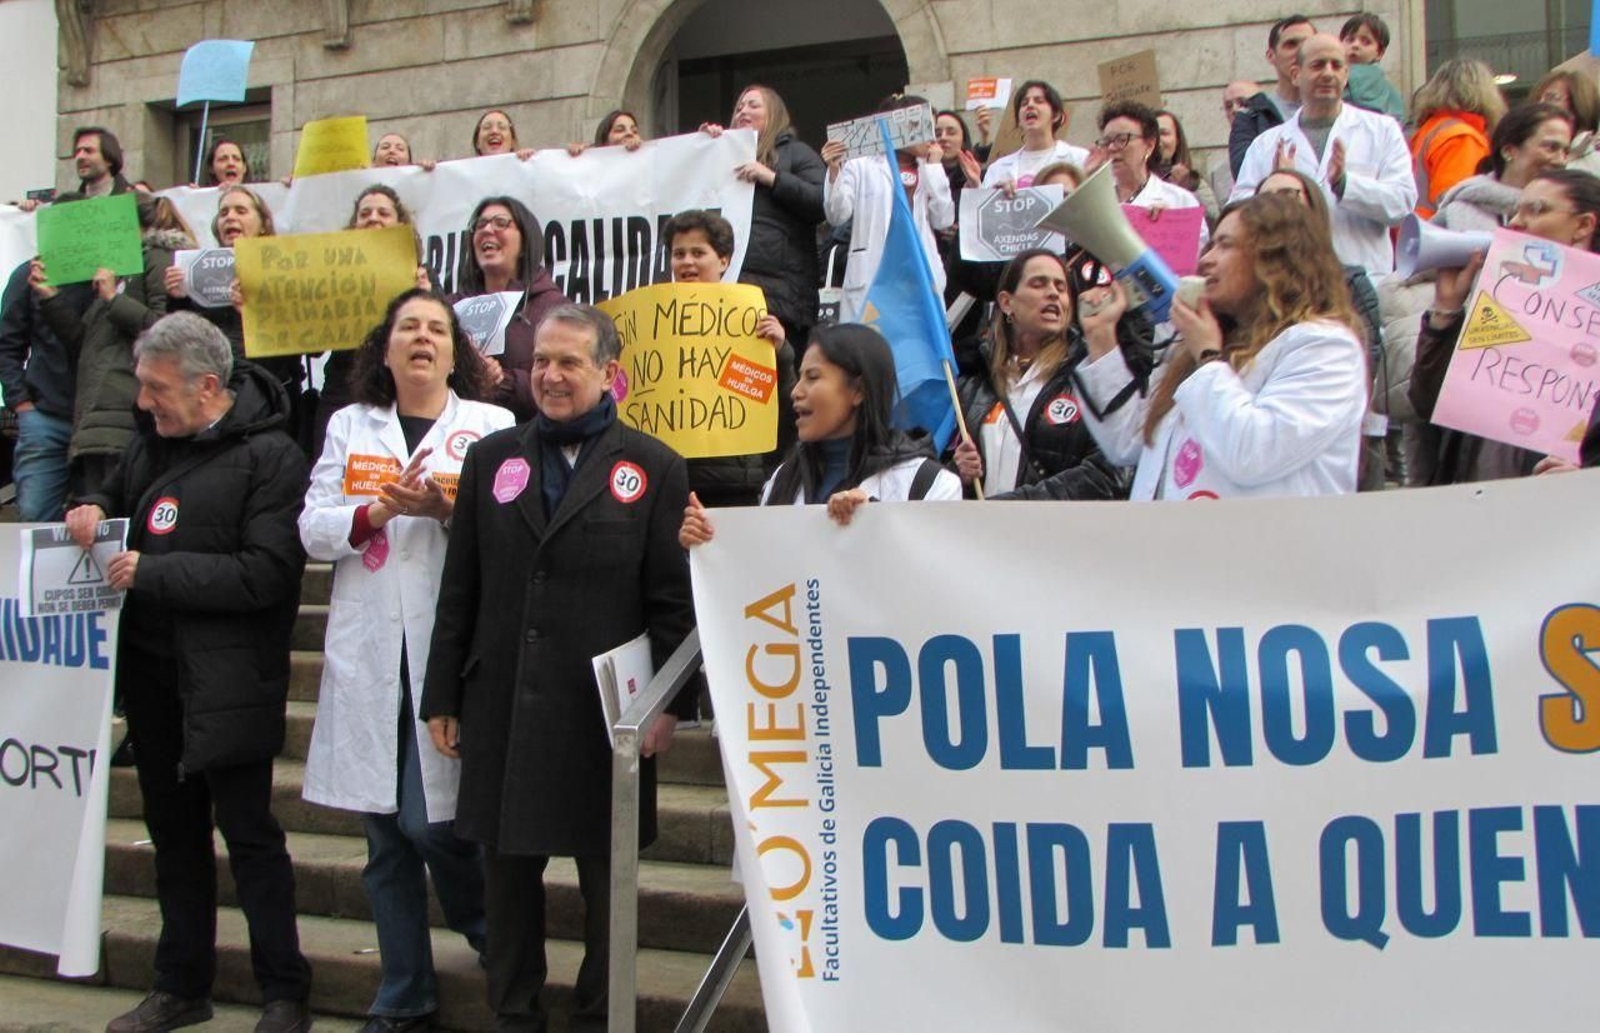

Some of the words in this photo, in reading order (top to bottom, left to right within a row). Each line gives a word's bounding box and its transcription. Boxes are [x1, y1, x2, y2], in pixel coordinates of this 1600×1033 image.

[994, 197, 1036, 213] STOP
[994, 232, 1039, 243] AXENDAS
[202, 256, 235, 269] STOP
[324, 246, 367, 266] UNA
[256, 296, 377, 330] PRIMARIA
[466, 300, 497, 317] STOP
[298, 317, 364, 347] CALI
[632, 349, 664, 392] NO
[678, 346, 732, 379] HAY
[731, 360, 774, 384] MÉDICOS
[1472, 346, 1595, 413] RESPON
[727, 377, 764, 399] HUELGA
[626, 388, 747, 434] SANIDAD
[1051, 400, 1076, 419] 30
[454, 436, 470, 449] 3
[502, 464, 523, 475] STOP
[615, 469, 640, 492] 30
[351, 480, 382, 491] HUEL
[155, 507, 176, 522] 30
[45, 589, 76, 600] CUPOS
[78, 587, 94, 599] SEN
[0, 598, 109, 670] IDADE
[806, 578, 831, 737] Independentes
[847, 630, 1135, 771] POLA
[1174, 616, 1499, 767] NOSA
[815, 743, 836, 813] Galicia
[818, 818, 837, 845] de
[862, 816, 1172, 949] COIDA
[1211, 820, 1281, 947] A
[1319, 804, 1600, 951] QUEN
[819, 850, 840, 982] Facultativos
